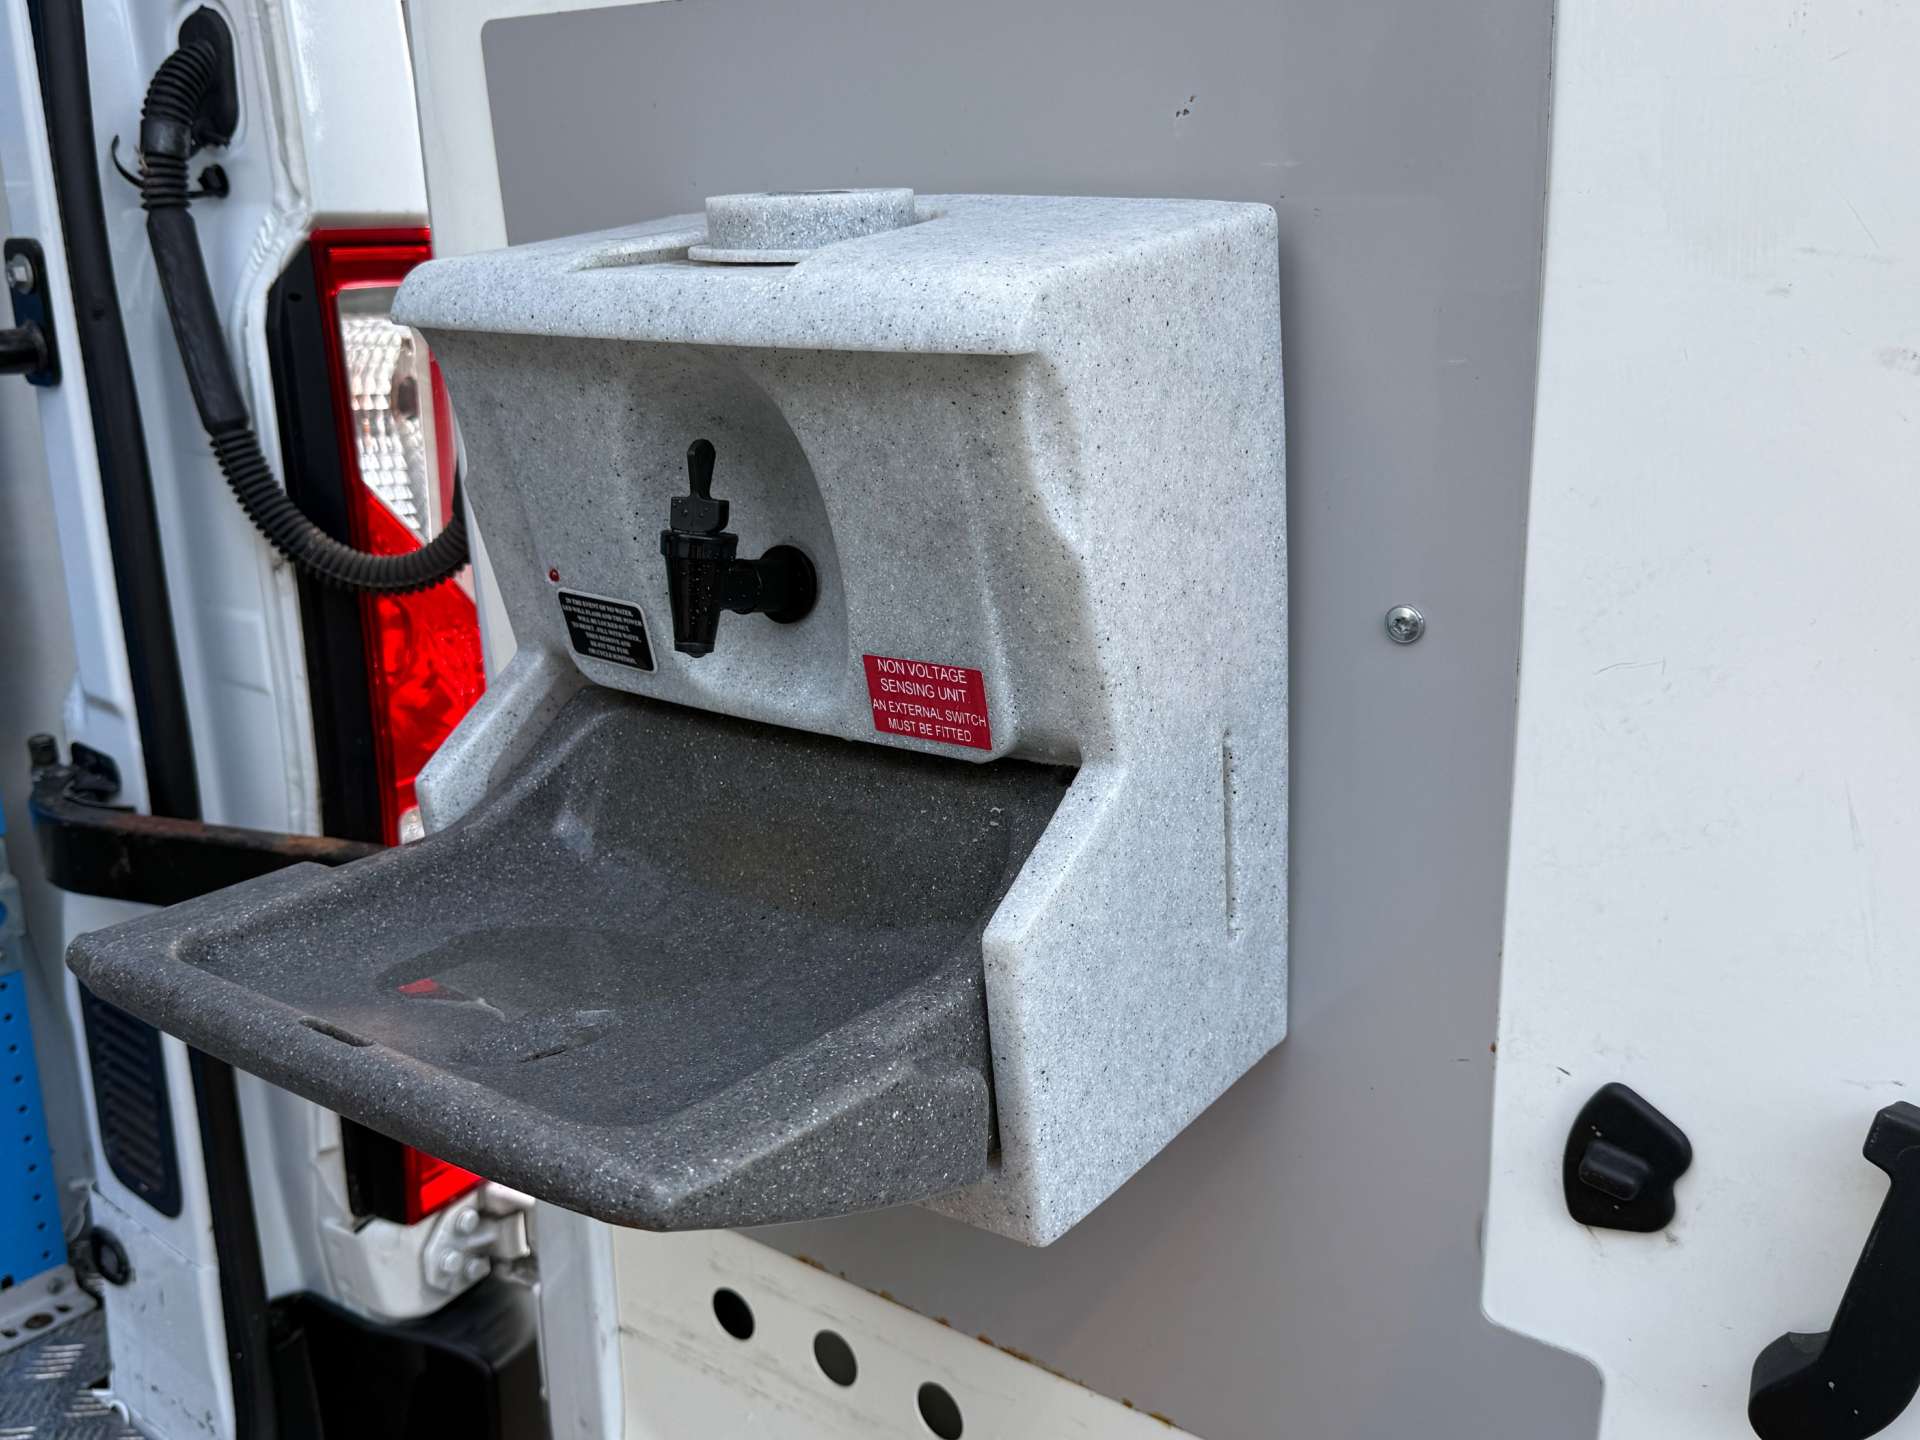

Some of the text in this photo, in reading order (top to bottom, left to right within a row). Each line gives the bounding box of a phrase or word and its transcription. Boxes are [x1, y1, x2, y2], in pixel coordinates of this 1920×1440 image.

[877, 659, 967, 684] NON VOLTAGE
[880, 678, 935, 698] SENSING
[873, 699, 987, 727] AN EXTERNAL SWITCH
[888, 718, 916, 732] MUST
[919, 723, 933, 735] BE
